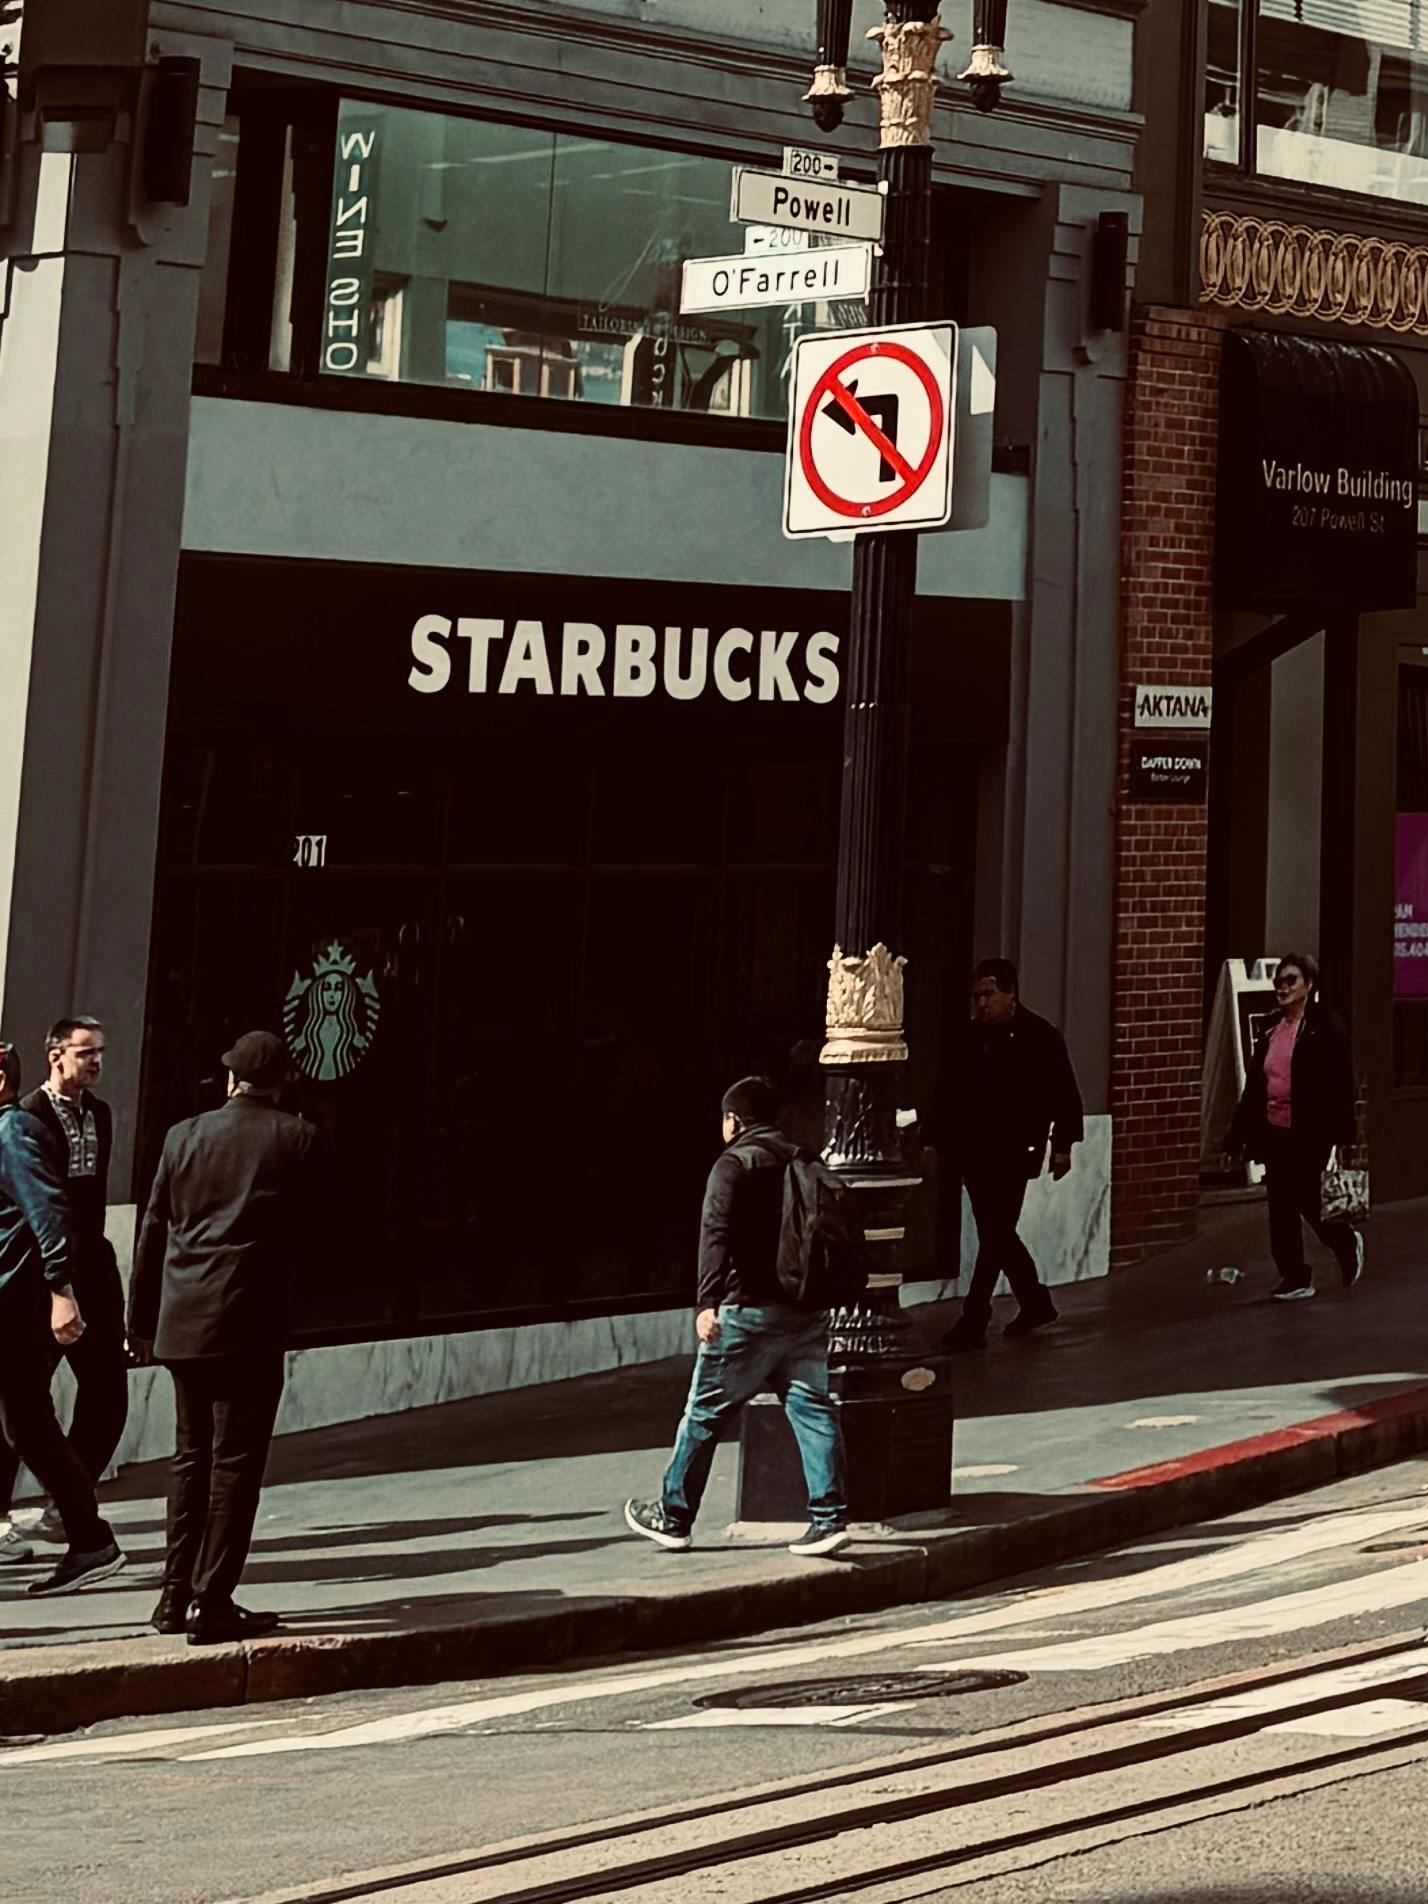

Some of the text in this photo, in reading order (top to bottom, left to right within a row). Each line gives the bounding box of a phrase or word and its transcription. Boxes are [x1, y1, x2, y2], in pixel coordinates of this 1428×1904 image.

[793, 153, 822, 175] 200
[773, 186, 851, 227] Powell
[712, 259, 839, 297] O'Farrell
[1261, 458, 1413, 510] Varlow Building
[407, 613, 841, 705] STARBUCKS
[1138, 693, 1209, 718] AKTANA
